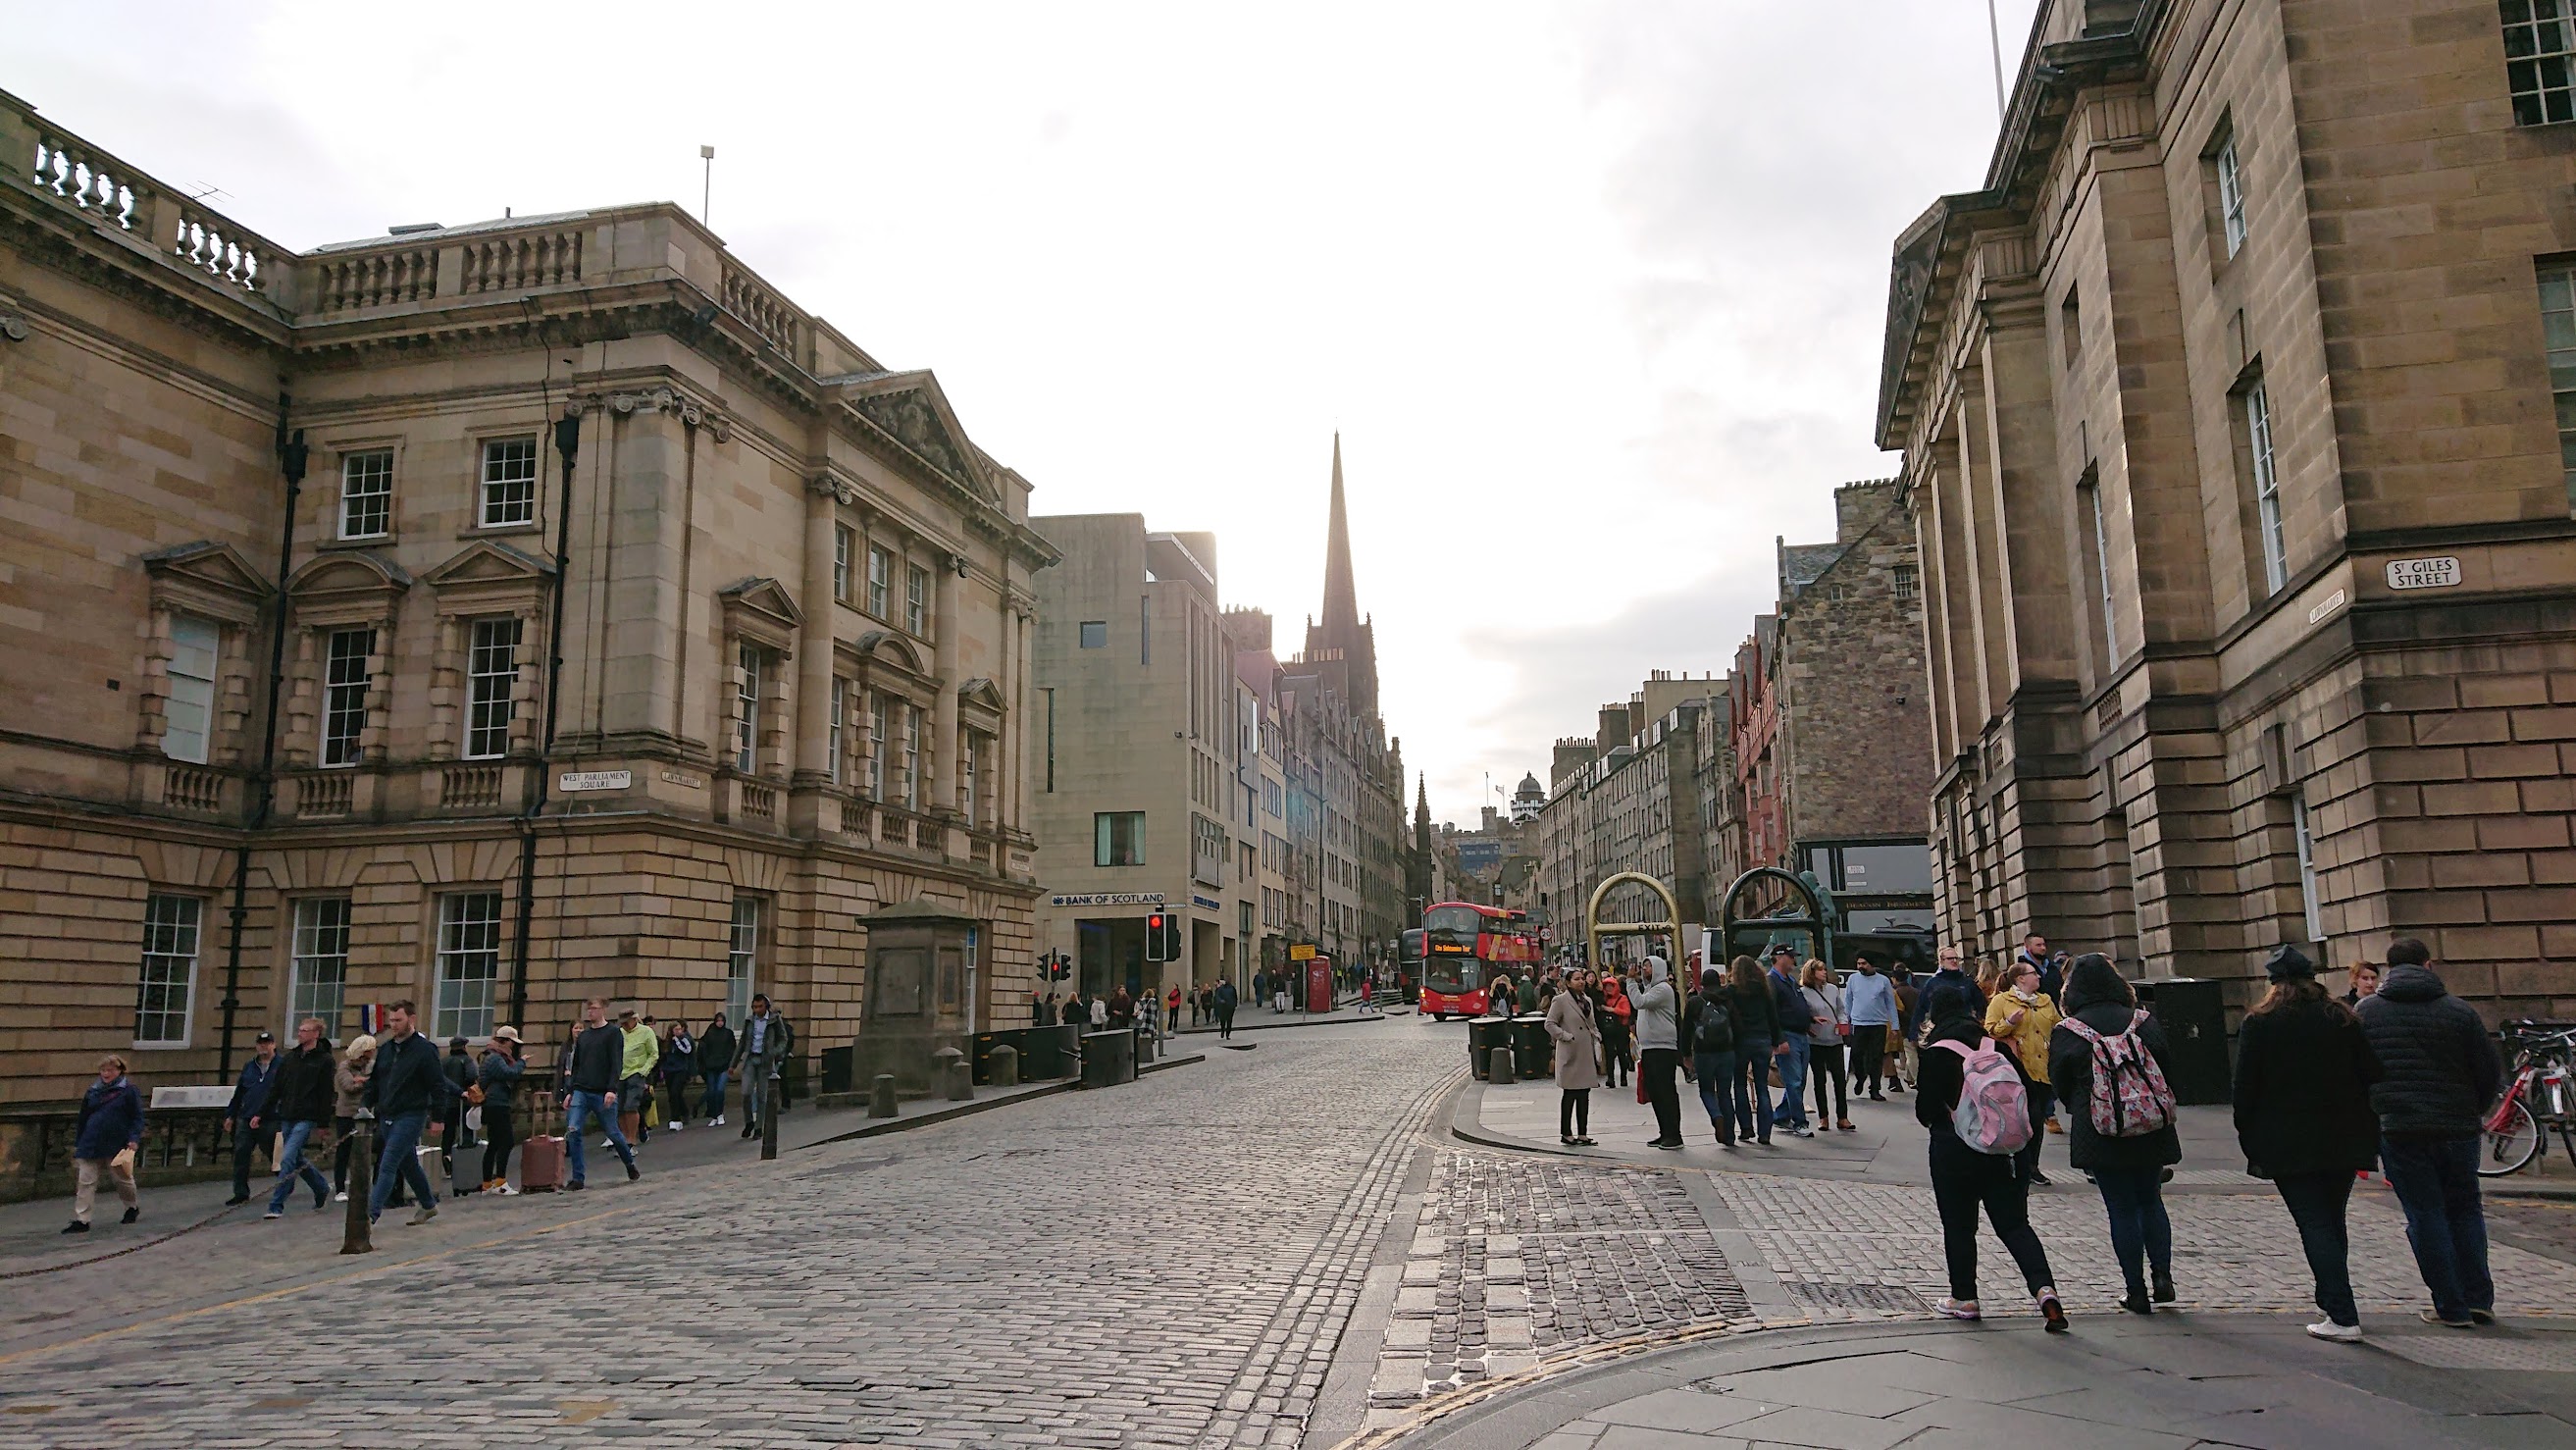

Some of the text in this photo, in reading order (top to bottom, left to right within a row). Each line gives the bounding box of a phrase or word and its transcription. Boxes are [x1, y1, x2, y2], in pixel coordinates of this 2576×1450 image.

[2411, 559, 2452, 573] GILES
[2397, 573, 2451, 587] STREET
[2311, 593, 2343, 621] LAWNMARKET
[585, 772, 629, 781] PARLIAMENT
[1065, 893, 1164, 906] BANK OF SCOTLAND
